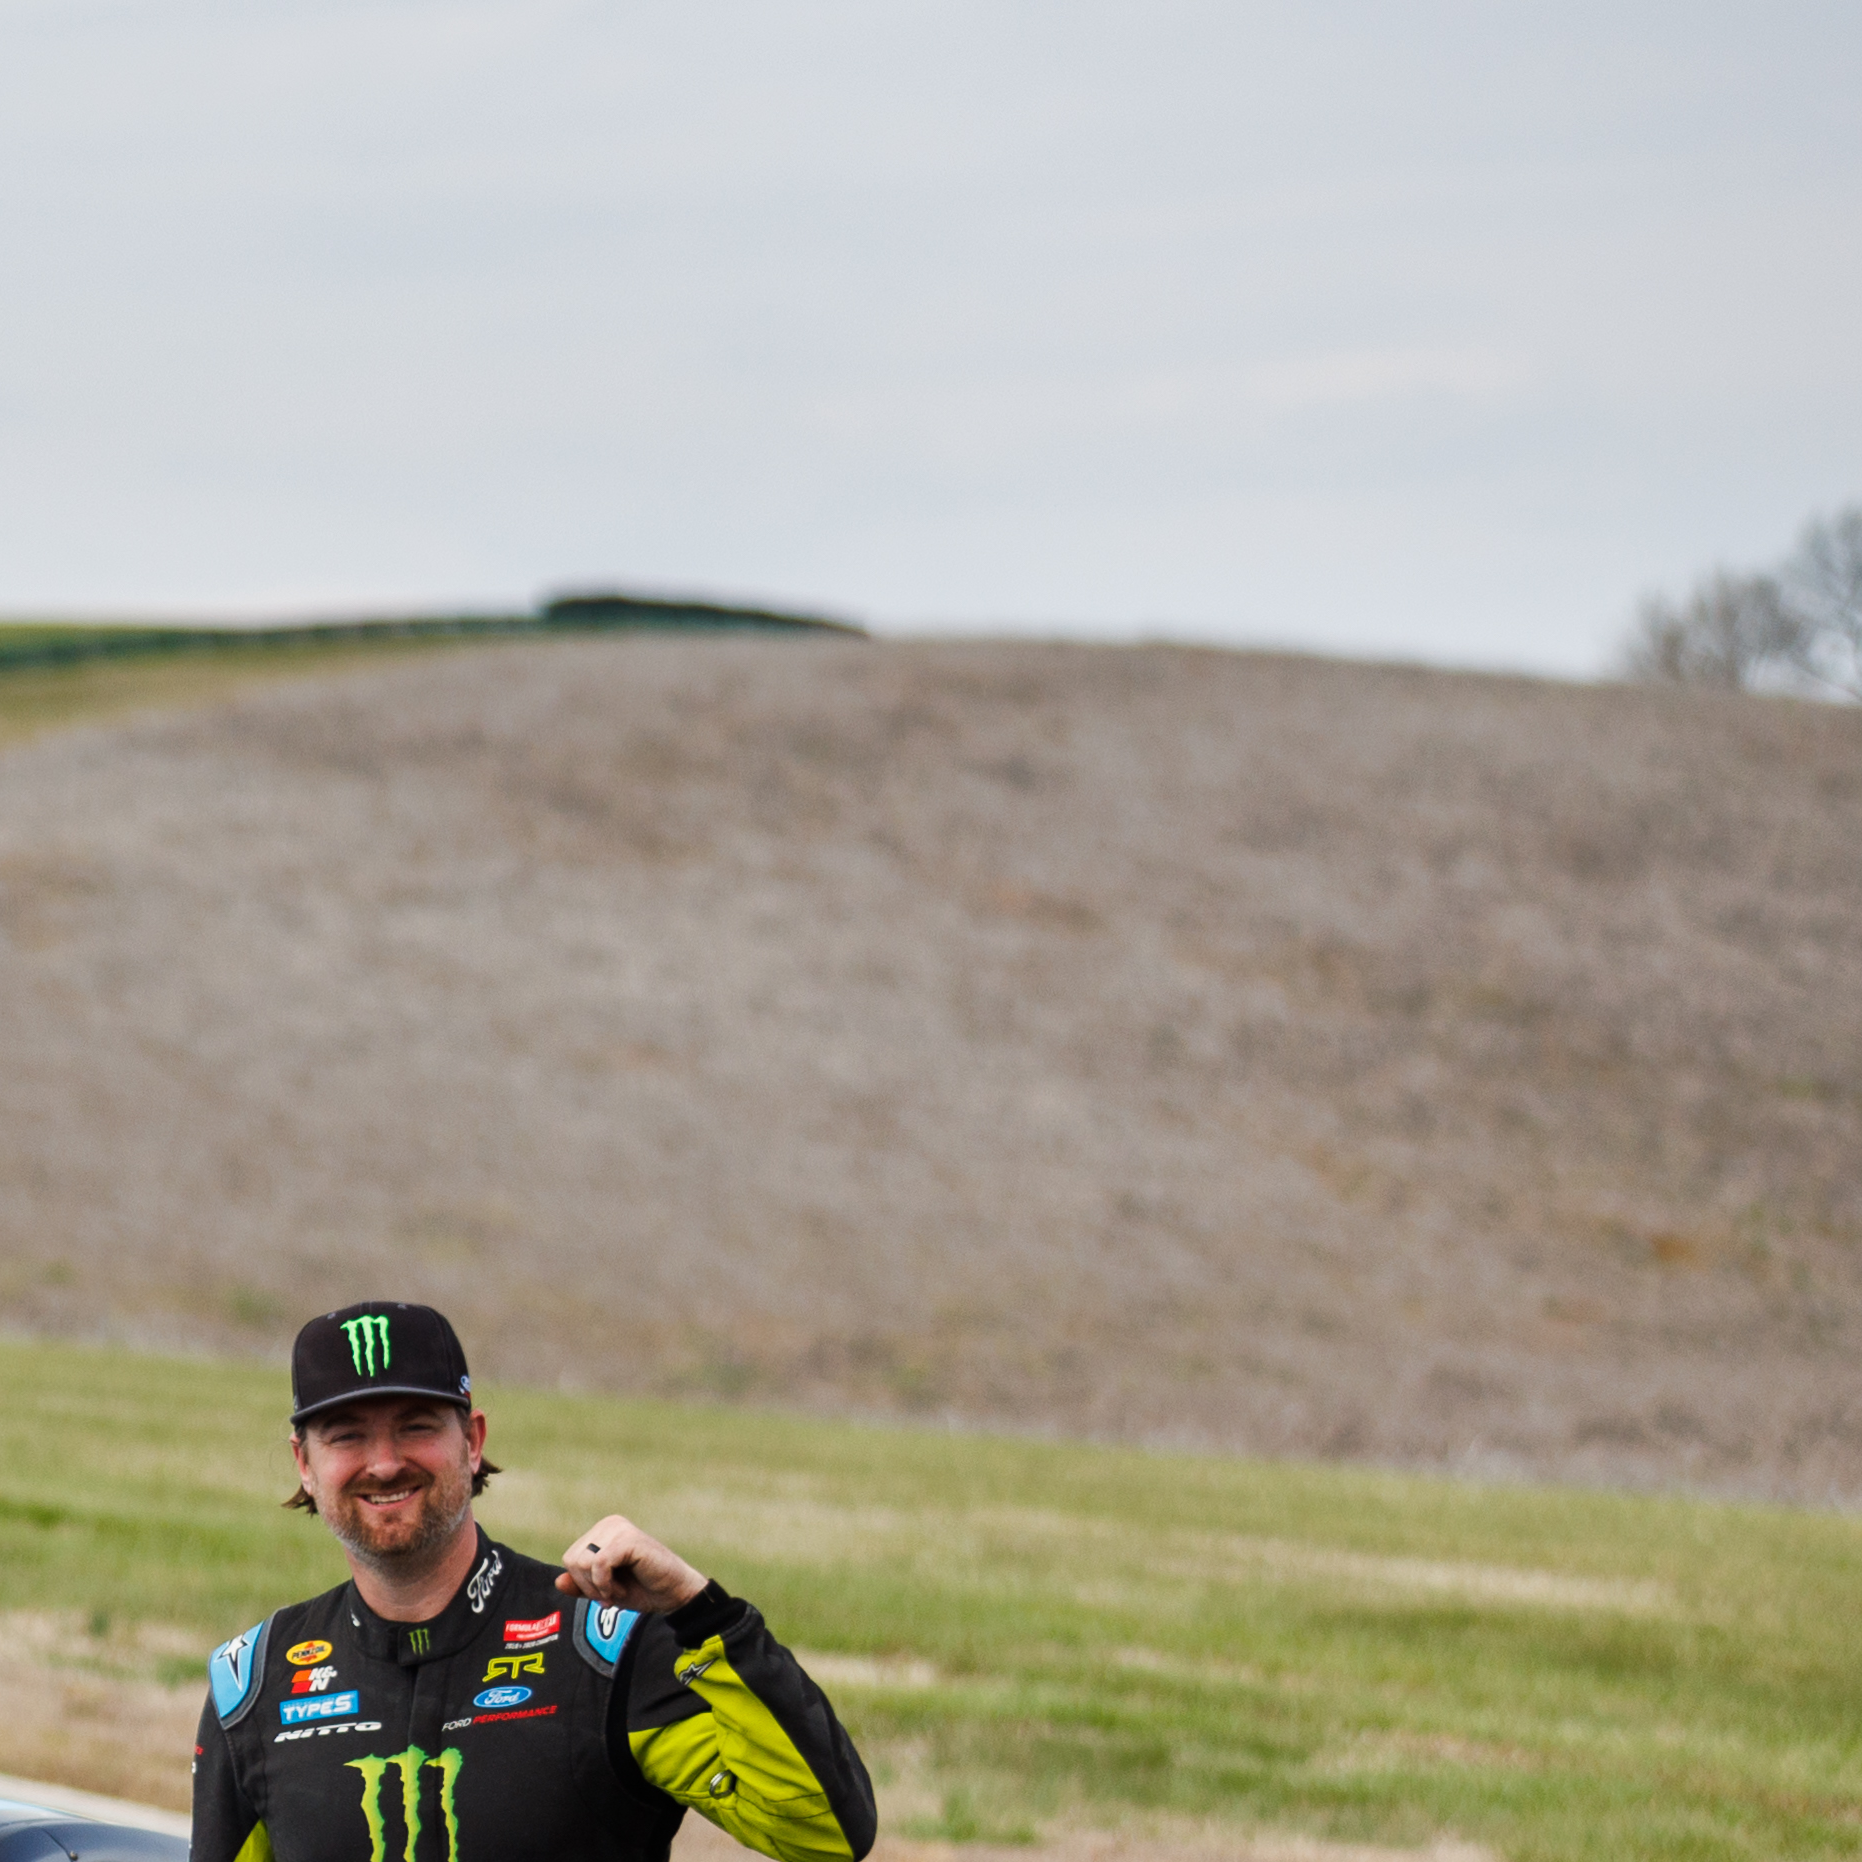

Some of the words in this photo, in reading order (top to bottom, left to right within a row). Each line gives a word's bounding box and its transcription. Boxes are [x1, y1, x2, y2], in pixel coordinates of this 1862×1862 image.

[467, 1550, 502, 1613] Ford
[484, 1689, 519, 1704] Ford
[442, 1718, 472, 1731] FORD
[472, 1705, 557, 1724] PERFORMANCE
[274, 1721, 382, 1742] NITTO
